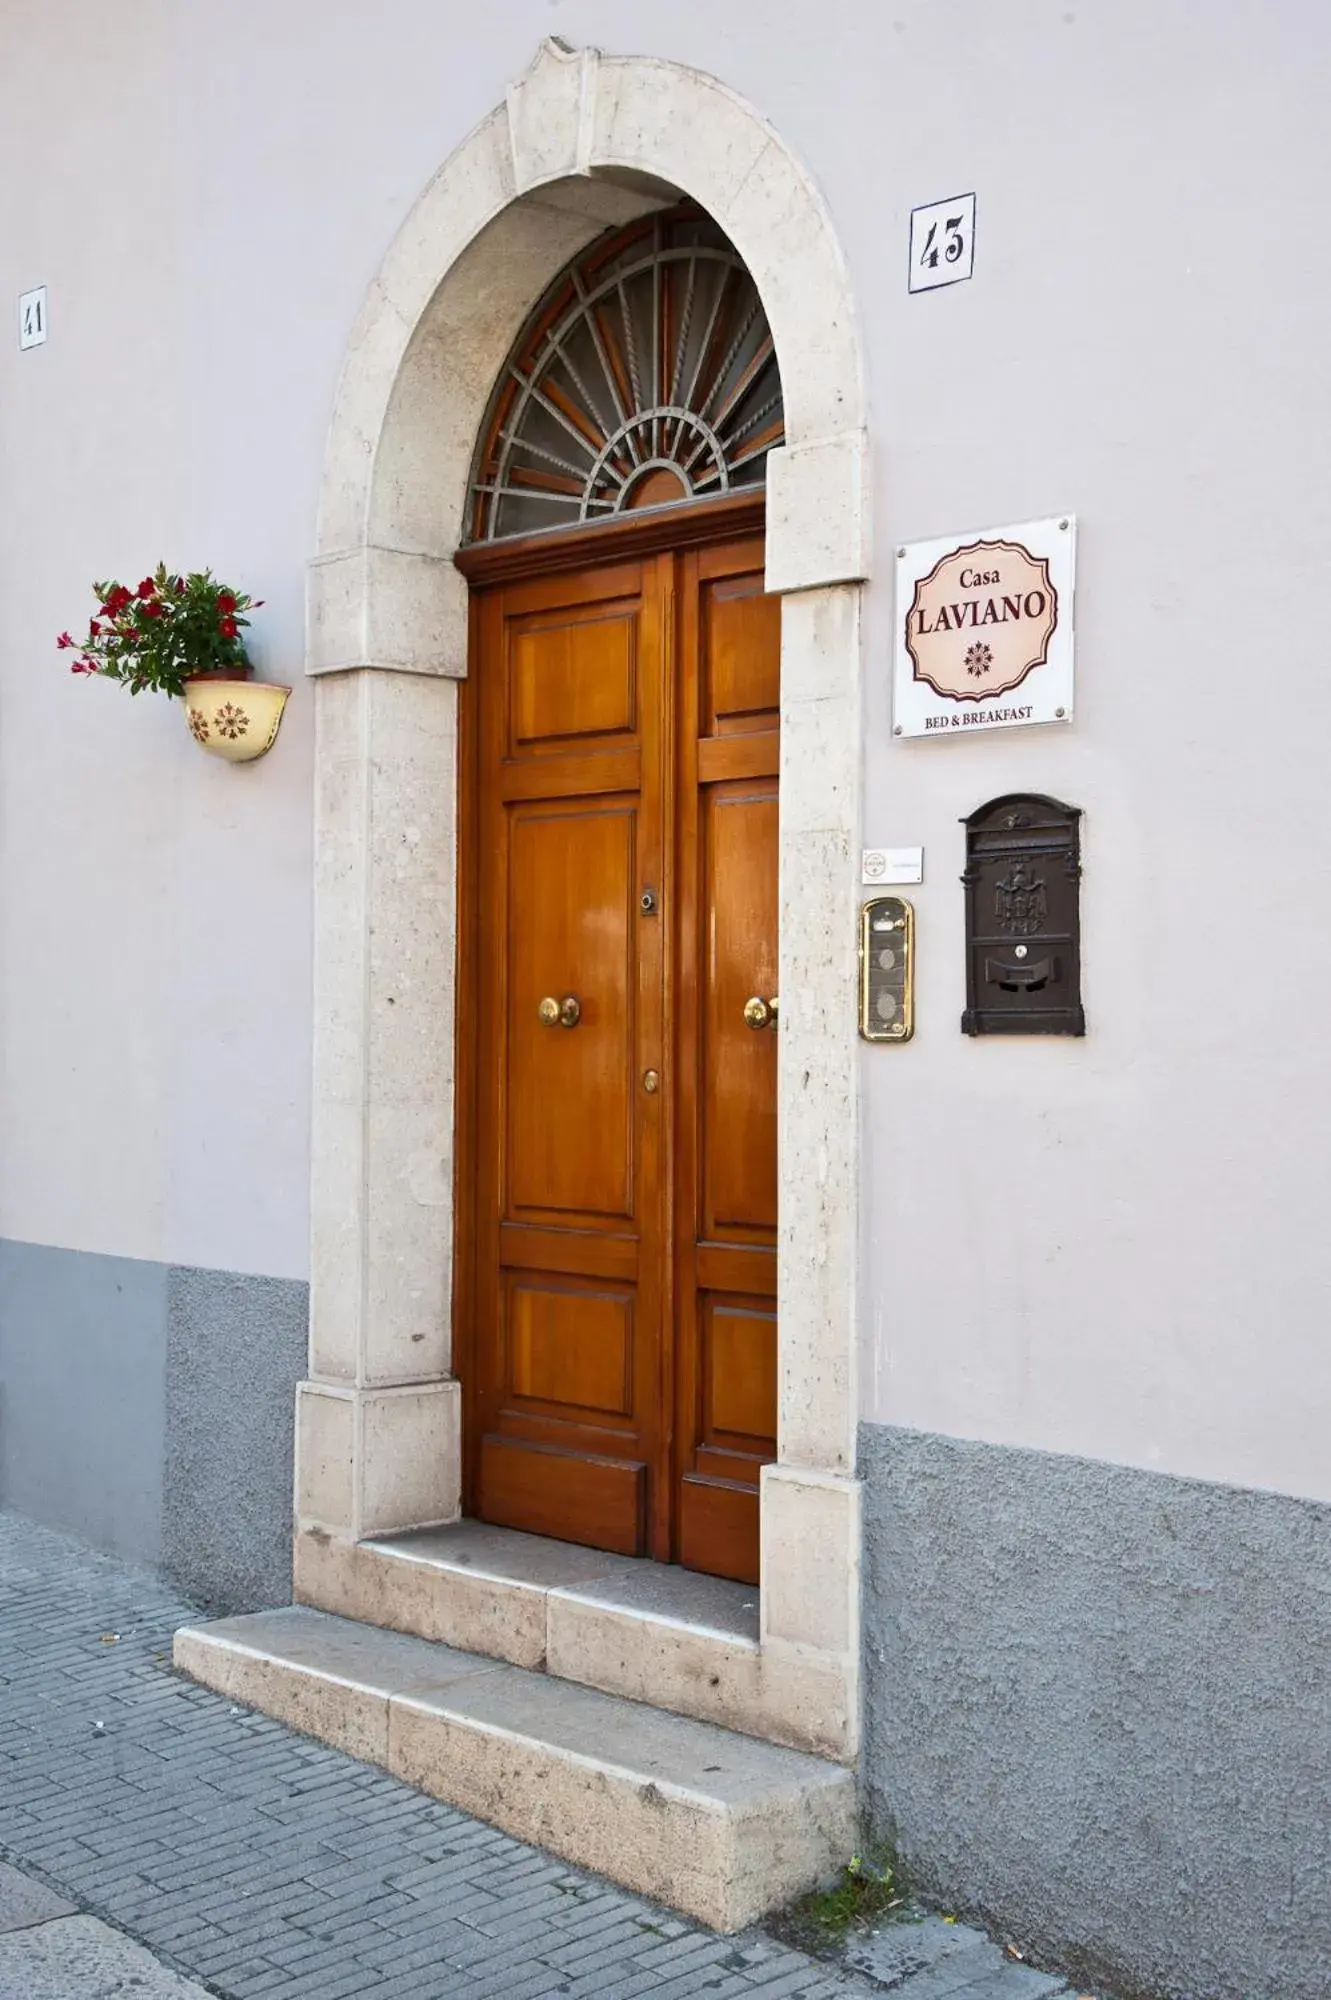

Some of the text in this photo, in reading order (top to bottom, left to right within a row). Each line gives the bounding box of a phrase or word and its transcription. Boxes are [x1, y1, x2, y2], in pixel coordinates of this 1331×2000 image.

[920, 214, 964, 269] 43
[24, 301, 41, 334] 41
[960, 569, 1001, 589] Casa
[917, 591, 1045, 634] LAVIANO
[925, 706, 1033, 730] BED & BREAKFAST
